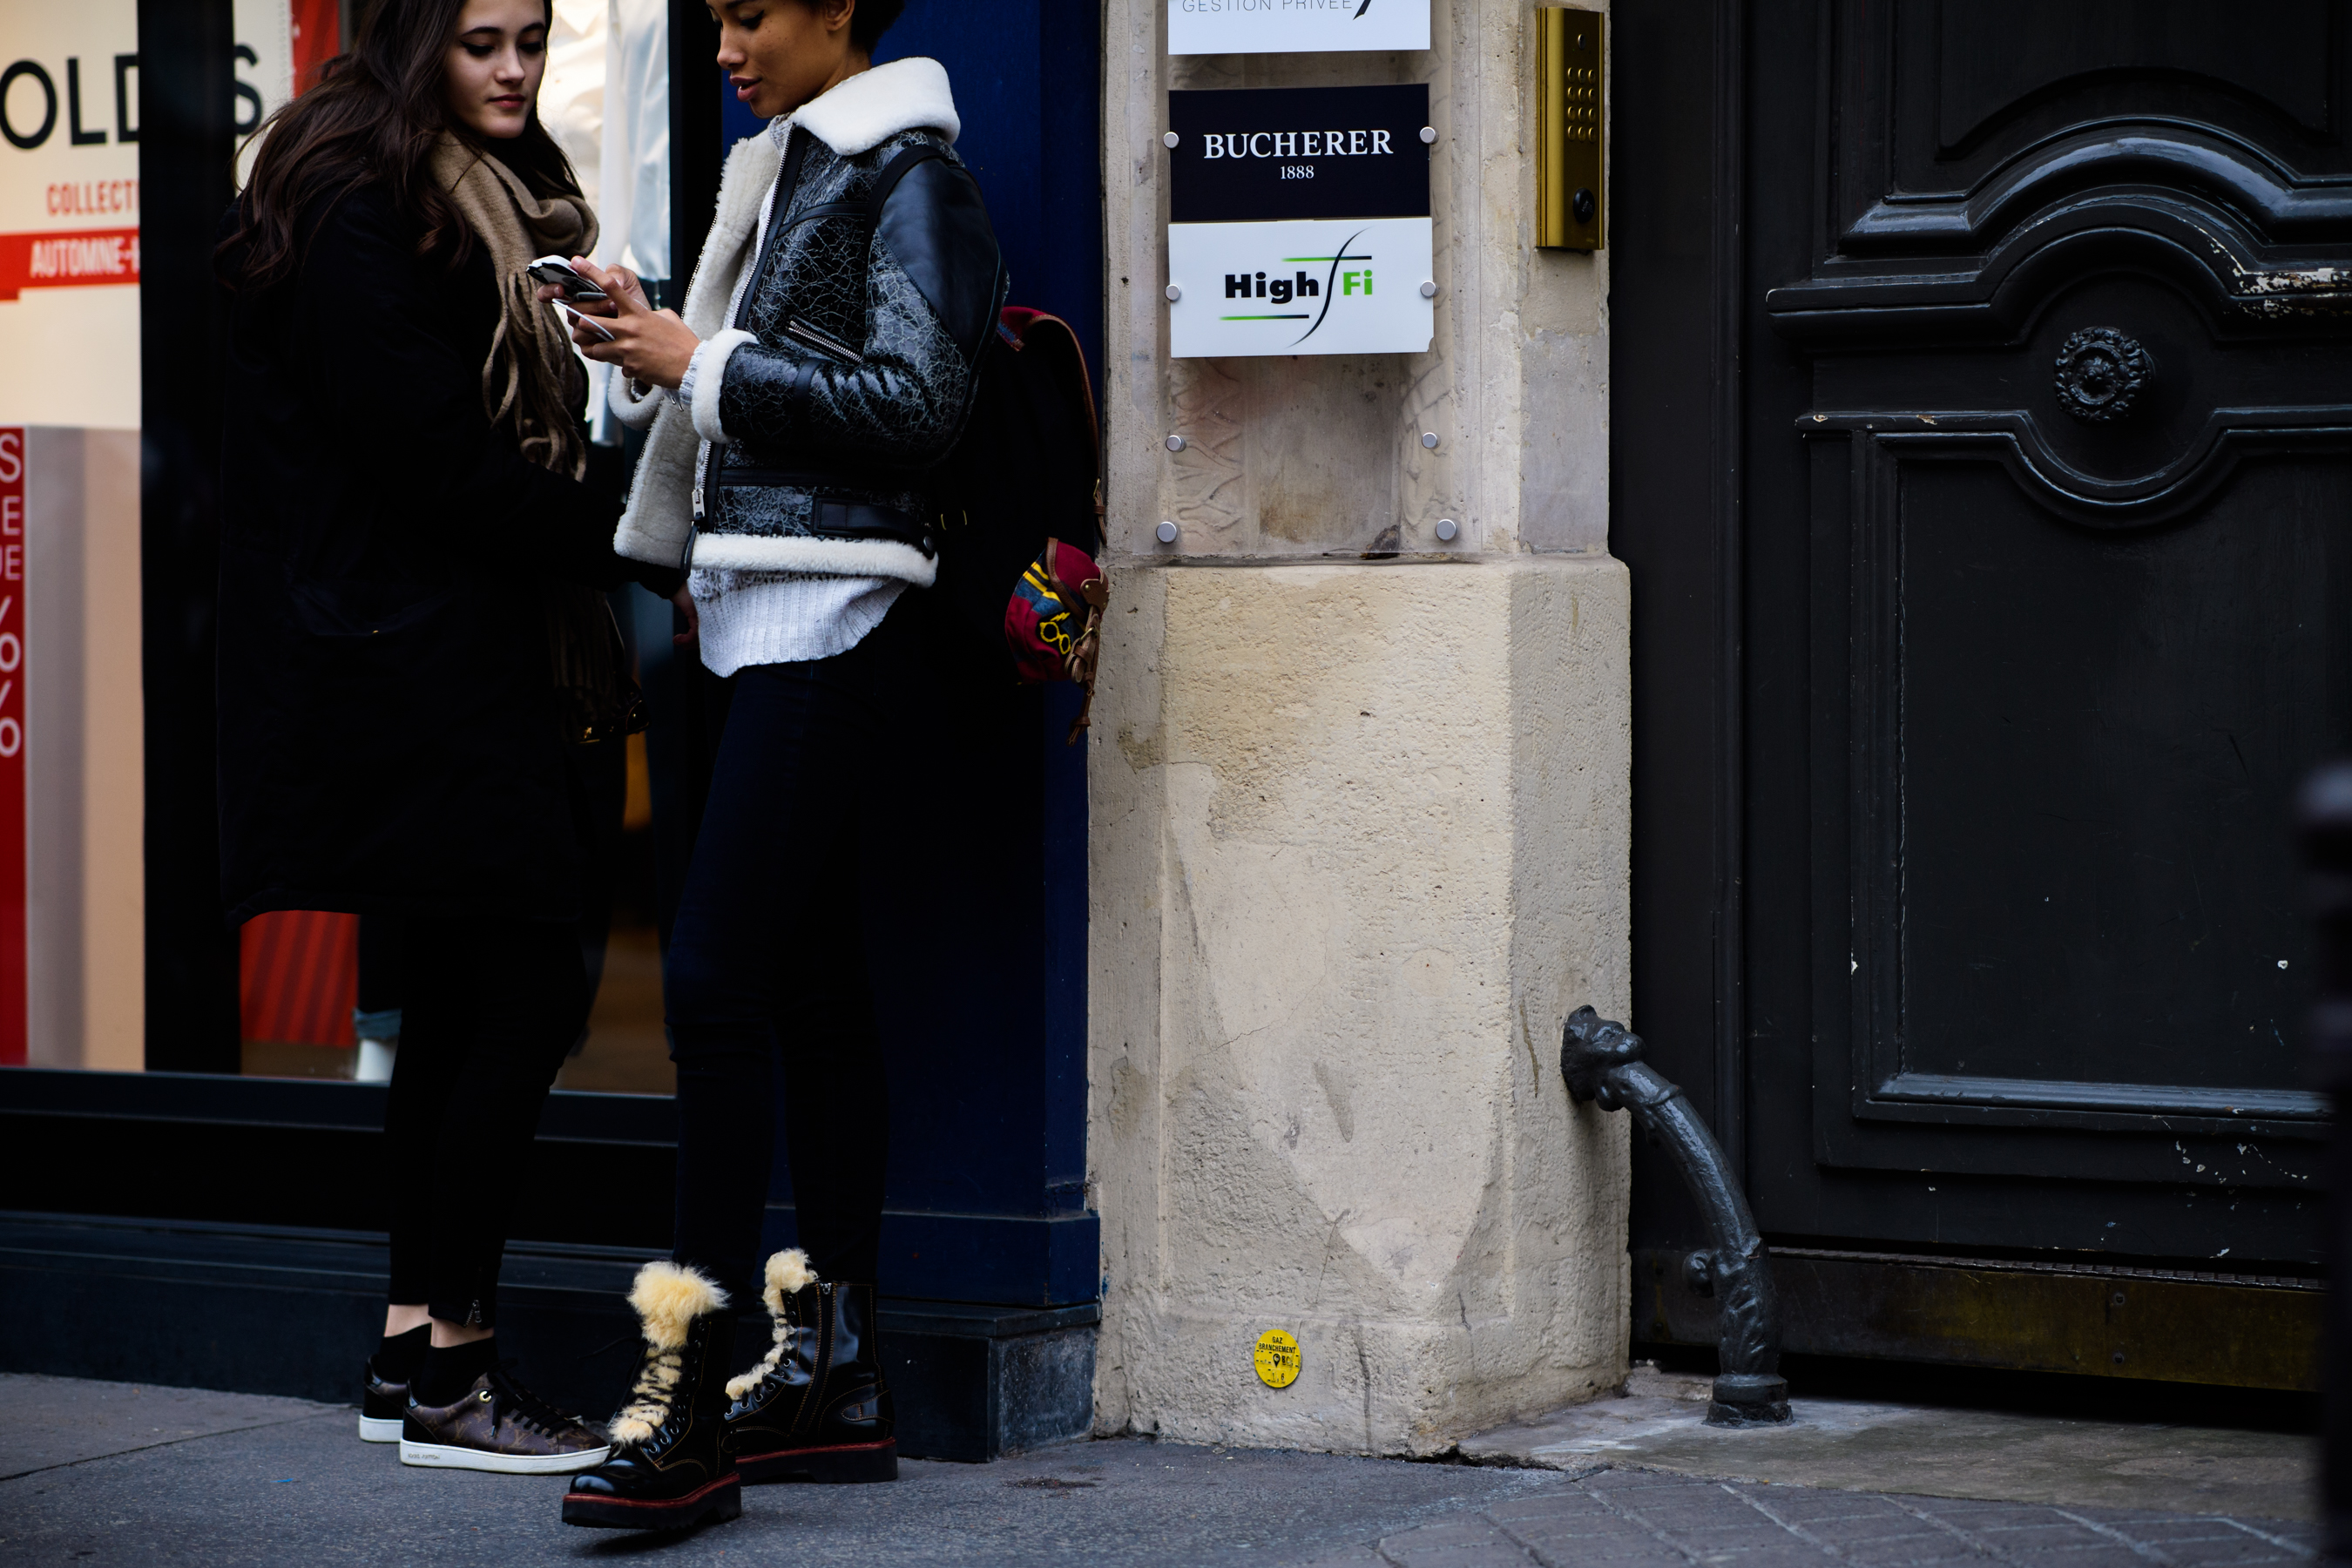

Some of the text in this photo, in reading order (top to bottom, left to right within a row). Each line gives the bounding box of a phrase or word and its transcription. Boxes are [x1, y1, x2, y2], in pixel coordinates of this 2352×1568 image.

[1182, 0, 1271, 12] GESTION
[1203, 130, 1394, 159] BUCHERER
[1280, 165, 1315, 179] 1888
[1225, 269, 1373, 304] High Fi
[1259, 1342, 1296, 1354] BRANCHEMENT
